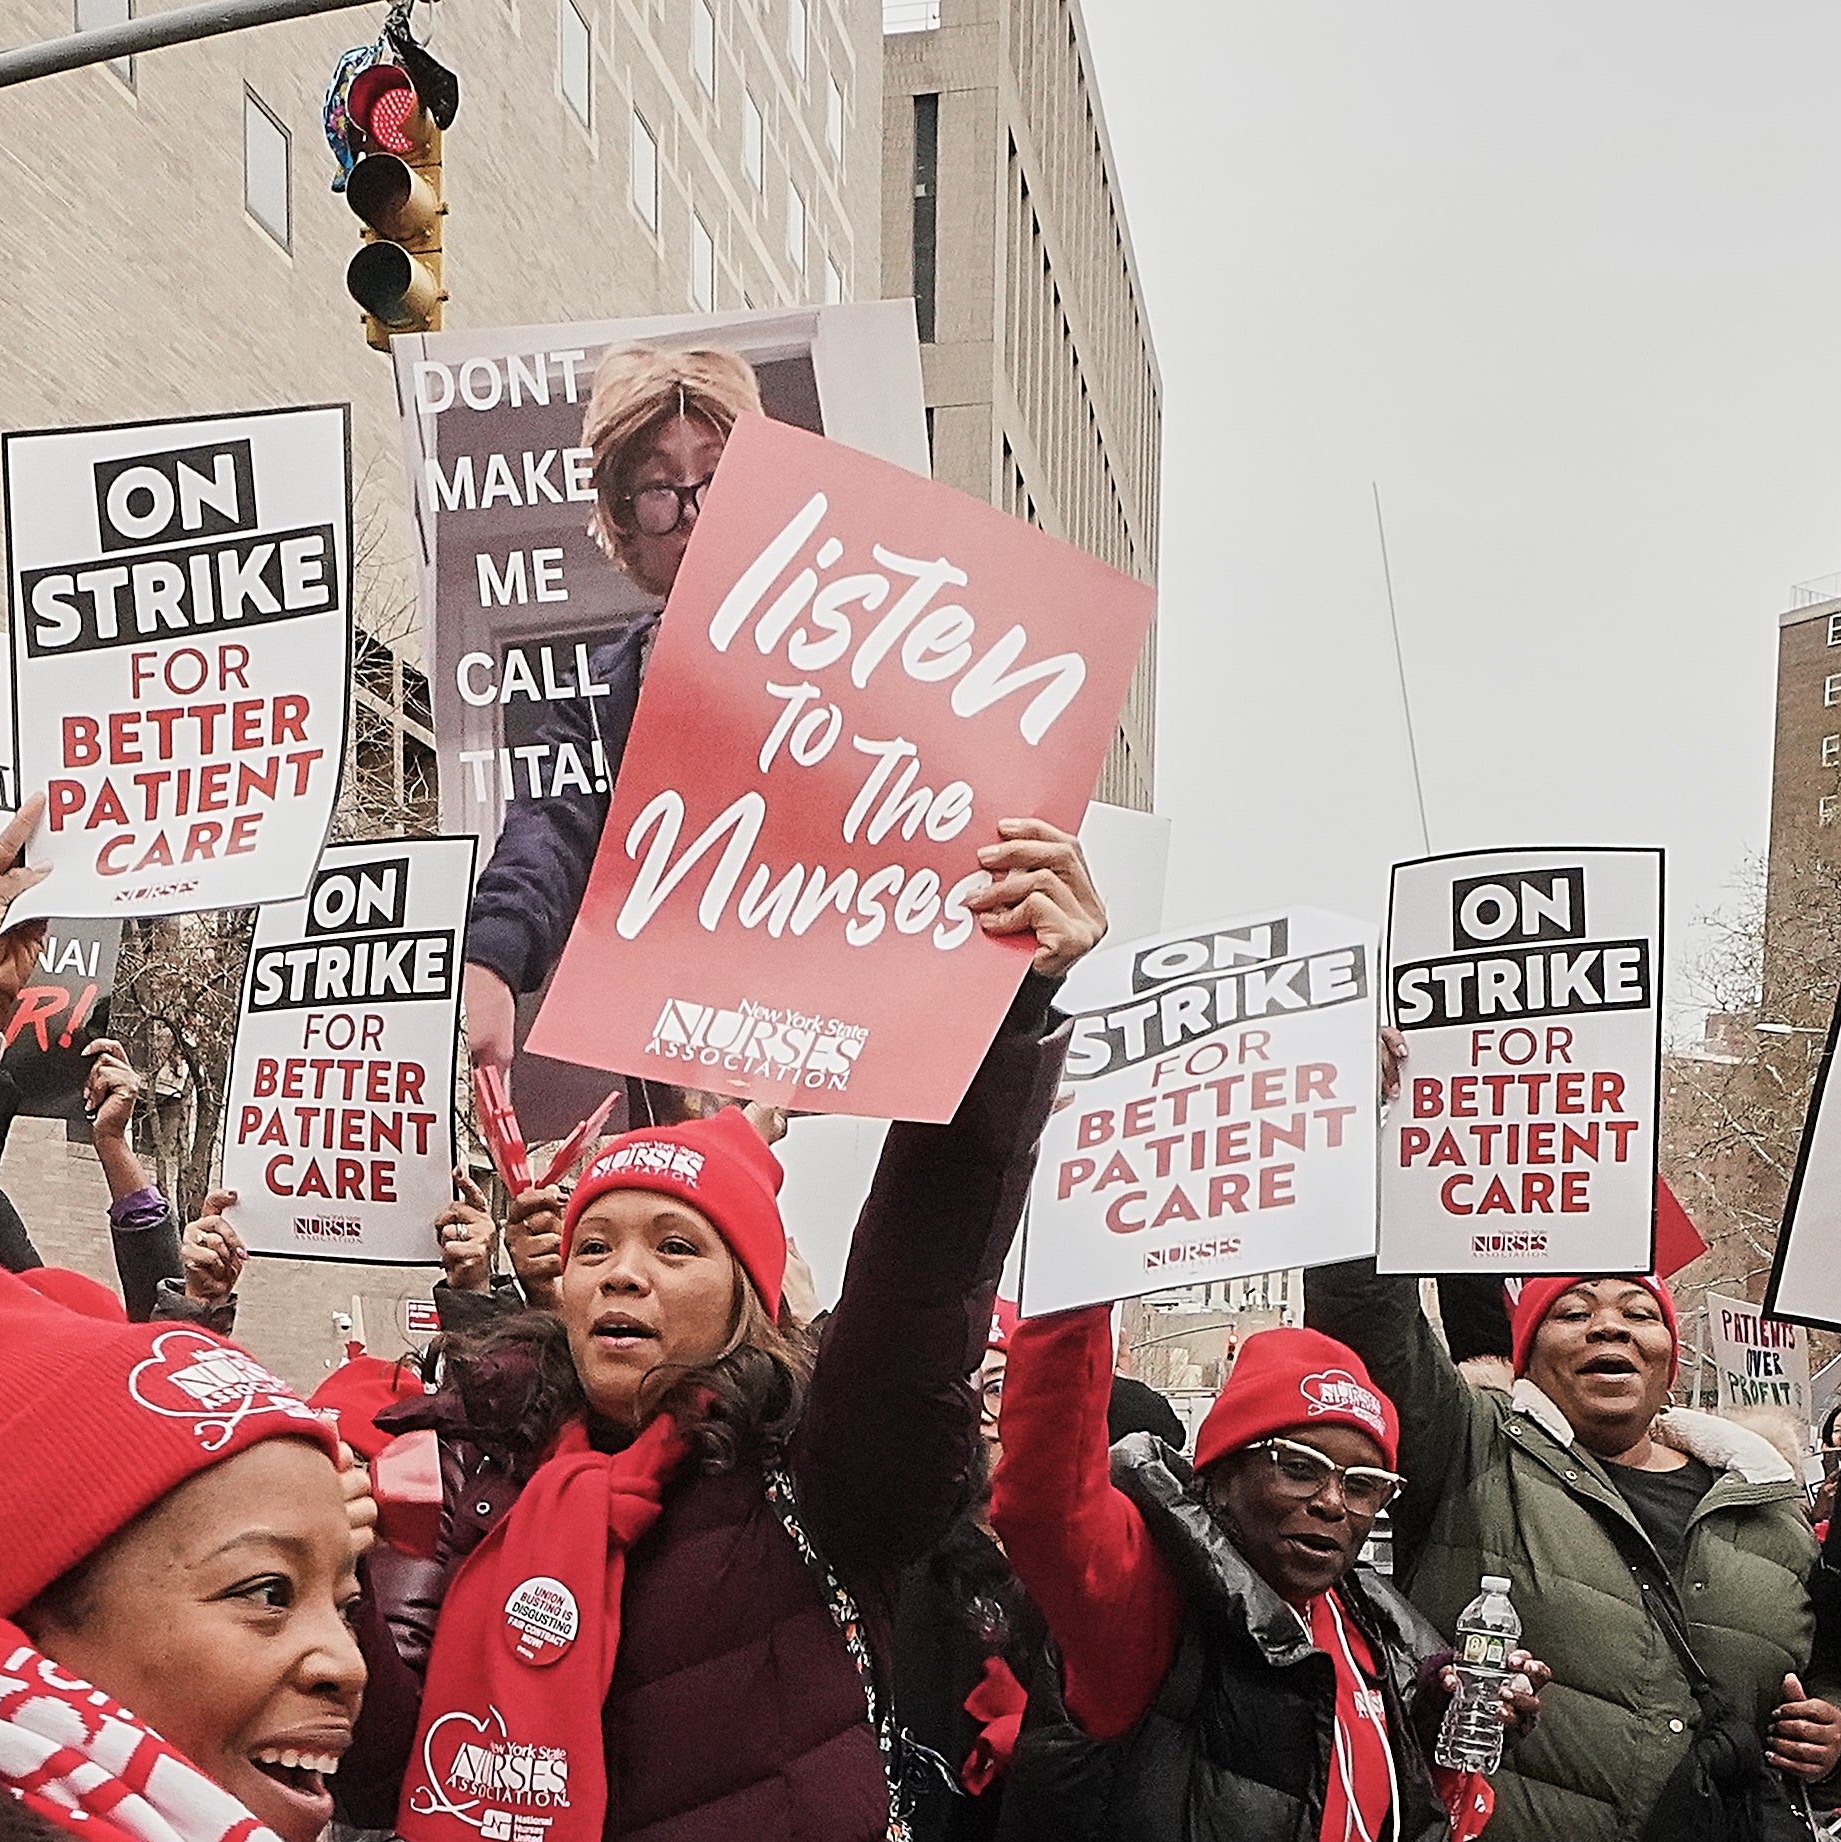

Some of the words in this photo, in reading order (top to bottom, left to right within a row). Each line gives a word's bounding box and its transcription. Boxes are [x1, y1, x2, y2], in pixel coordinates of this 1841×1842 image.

[413, 350, 586, 414] DONT
[107, 452, 240, 540] ON
[425, 448, 599, 511] MAKE
[31, 535, 329, 647] STRIKE
[475, 549, 569, 607] ME
[132, 645, 249, 698] FOR
[457, 643, 610, 705] CALL
[63, 695, 309, 768] BETTER
[49, 751, 323, 831] PATIENT
[460, 741, 607, 801] TITA!
[843, 734, 973, 845] The
[96, 813, 263, 877] CARE
[616, 790, 993, 950] Nurses
[313, 869, 396, 928] ON
[1460, 878, 1571, 940] ON
[38, 937, 100, 977] NAI
[254, 938, 447, 1005] STRIKE
[1141, 925, 1271, 978] ON
[1067, 950, 1357, 1074] STRIKE
[1397, 947, 1643, 1025] STRIKE
[303, 1014, 384, 1051] FOR
[653, 998, 865, 1074] NURSES
[738, 998, 784, 1022] New
[784, 1009, 824, 1033] York
[825, 1019, 869, 1039] State
[1152, 1030, 1271, 1087] FOR
[1472, 1027, 1572, 1066] FOR
[253, 1059, 426, 1105] BETTER
[1077, 1064, 1337, 1150] BETTER
[1414, 1072, 1625, 1119] BETTER
[238, 1106, 437, 1155] PATIENT
[1058, 1107, 1357, 1200] PATIENT
[1400, 1122, 1638, 1167] PATIENT
[265, 1154, 397, 1202] CARE
[1106, 1164, 1296, 1233] CARE
[1441, 1172, 1590, 1214] CARE
[294, 1217, 363, 1236] NURSES
[1144, 1239, 1241, 1269] NURSES
[1472, 1235, 1548, 1251] NURSES
[1722, 1309, 1795, 1350] PATIENTS
[1746, 1349, 1783, 1377] OVER
[512, 1602, 572, 1635] DISGUSTING
[521, 1592, 561, 1616] BUSTING
[562, 1610, 573, 1621] IS
[535, 1587, 565, 1606] UNION
[525, 1624, 567, 1647] CONTRACT
[507, 1742, 536, 1758] York
[538, 1746, 566, 1760] State
